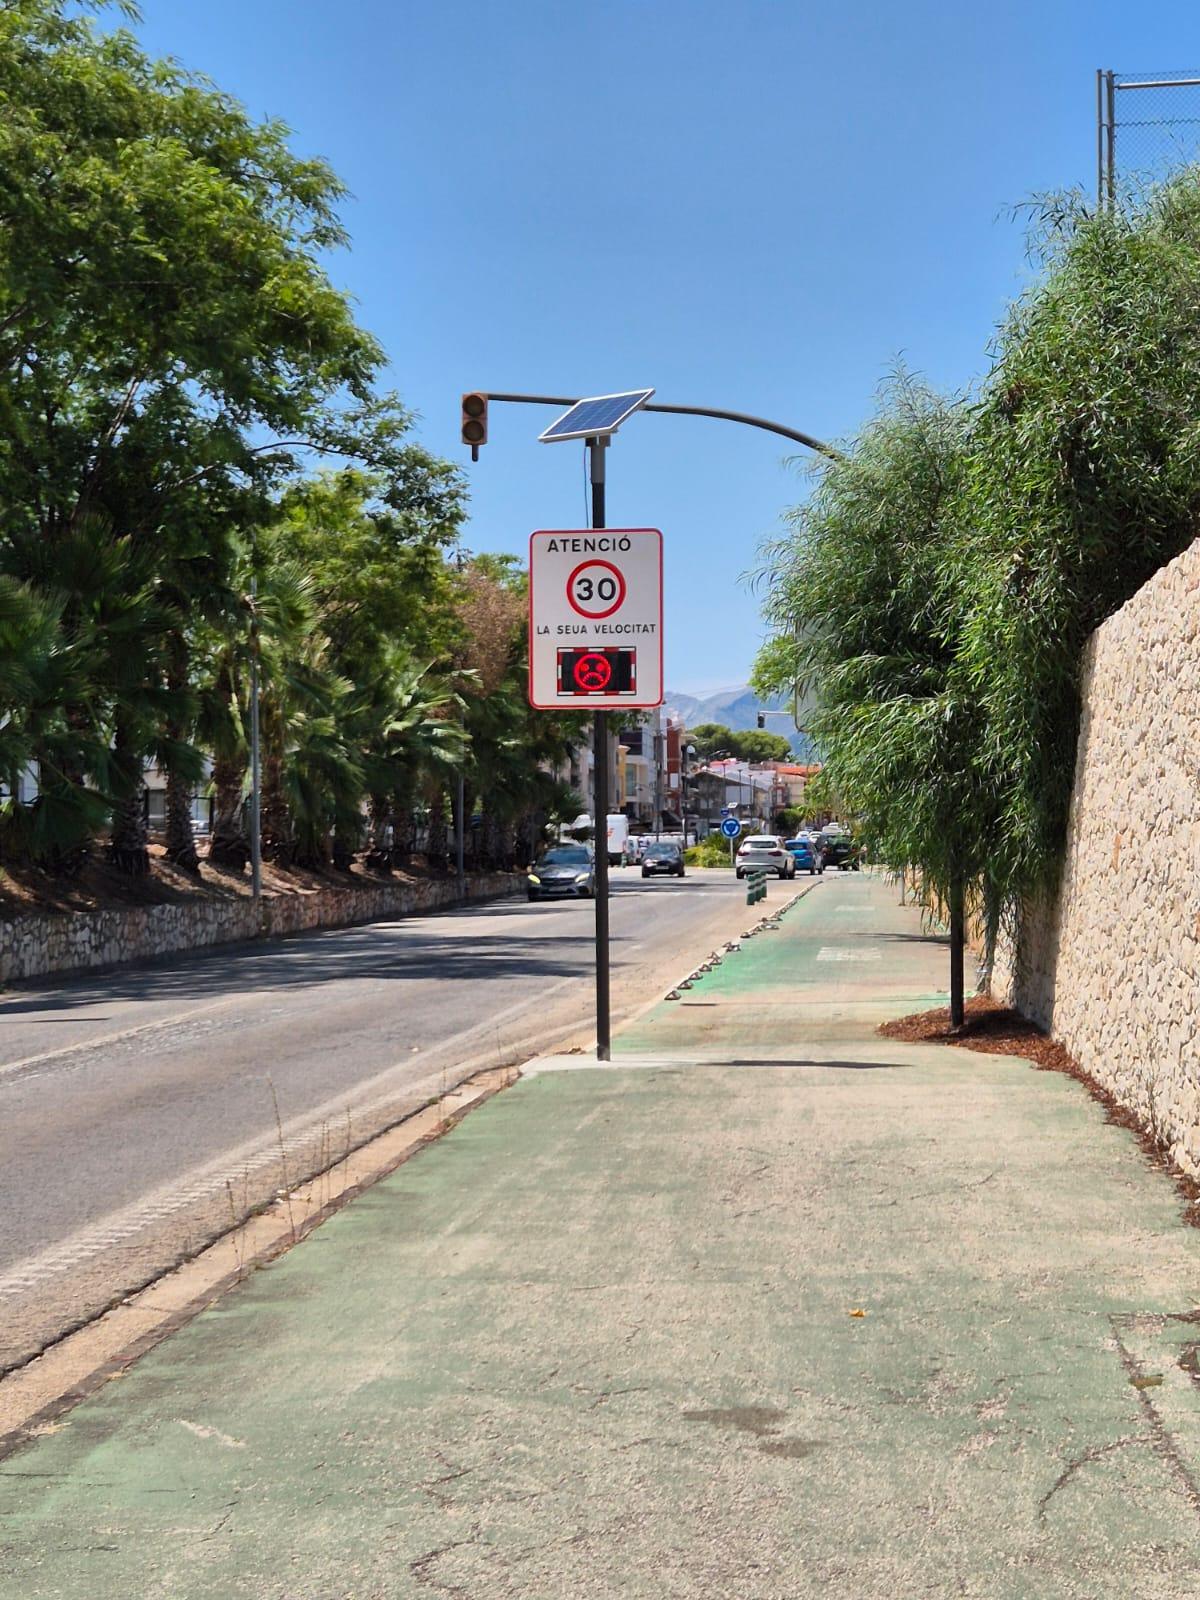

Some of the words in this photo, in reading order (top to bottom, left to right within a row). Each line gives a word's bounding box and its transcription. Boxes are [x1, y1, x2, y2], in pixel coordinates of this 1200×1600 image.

[547, 535, 631, 552] ATENCIÓ
[576, 577, 617, 601] 30
[537, 625, 550, 634] LA
[557, 624, 587, 634] SEUA
[594, 624, 656, 634] VELOCITAT
